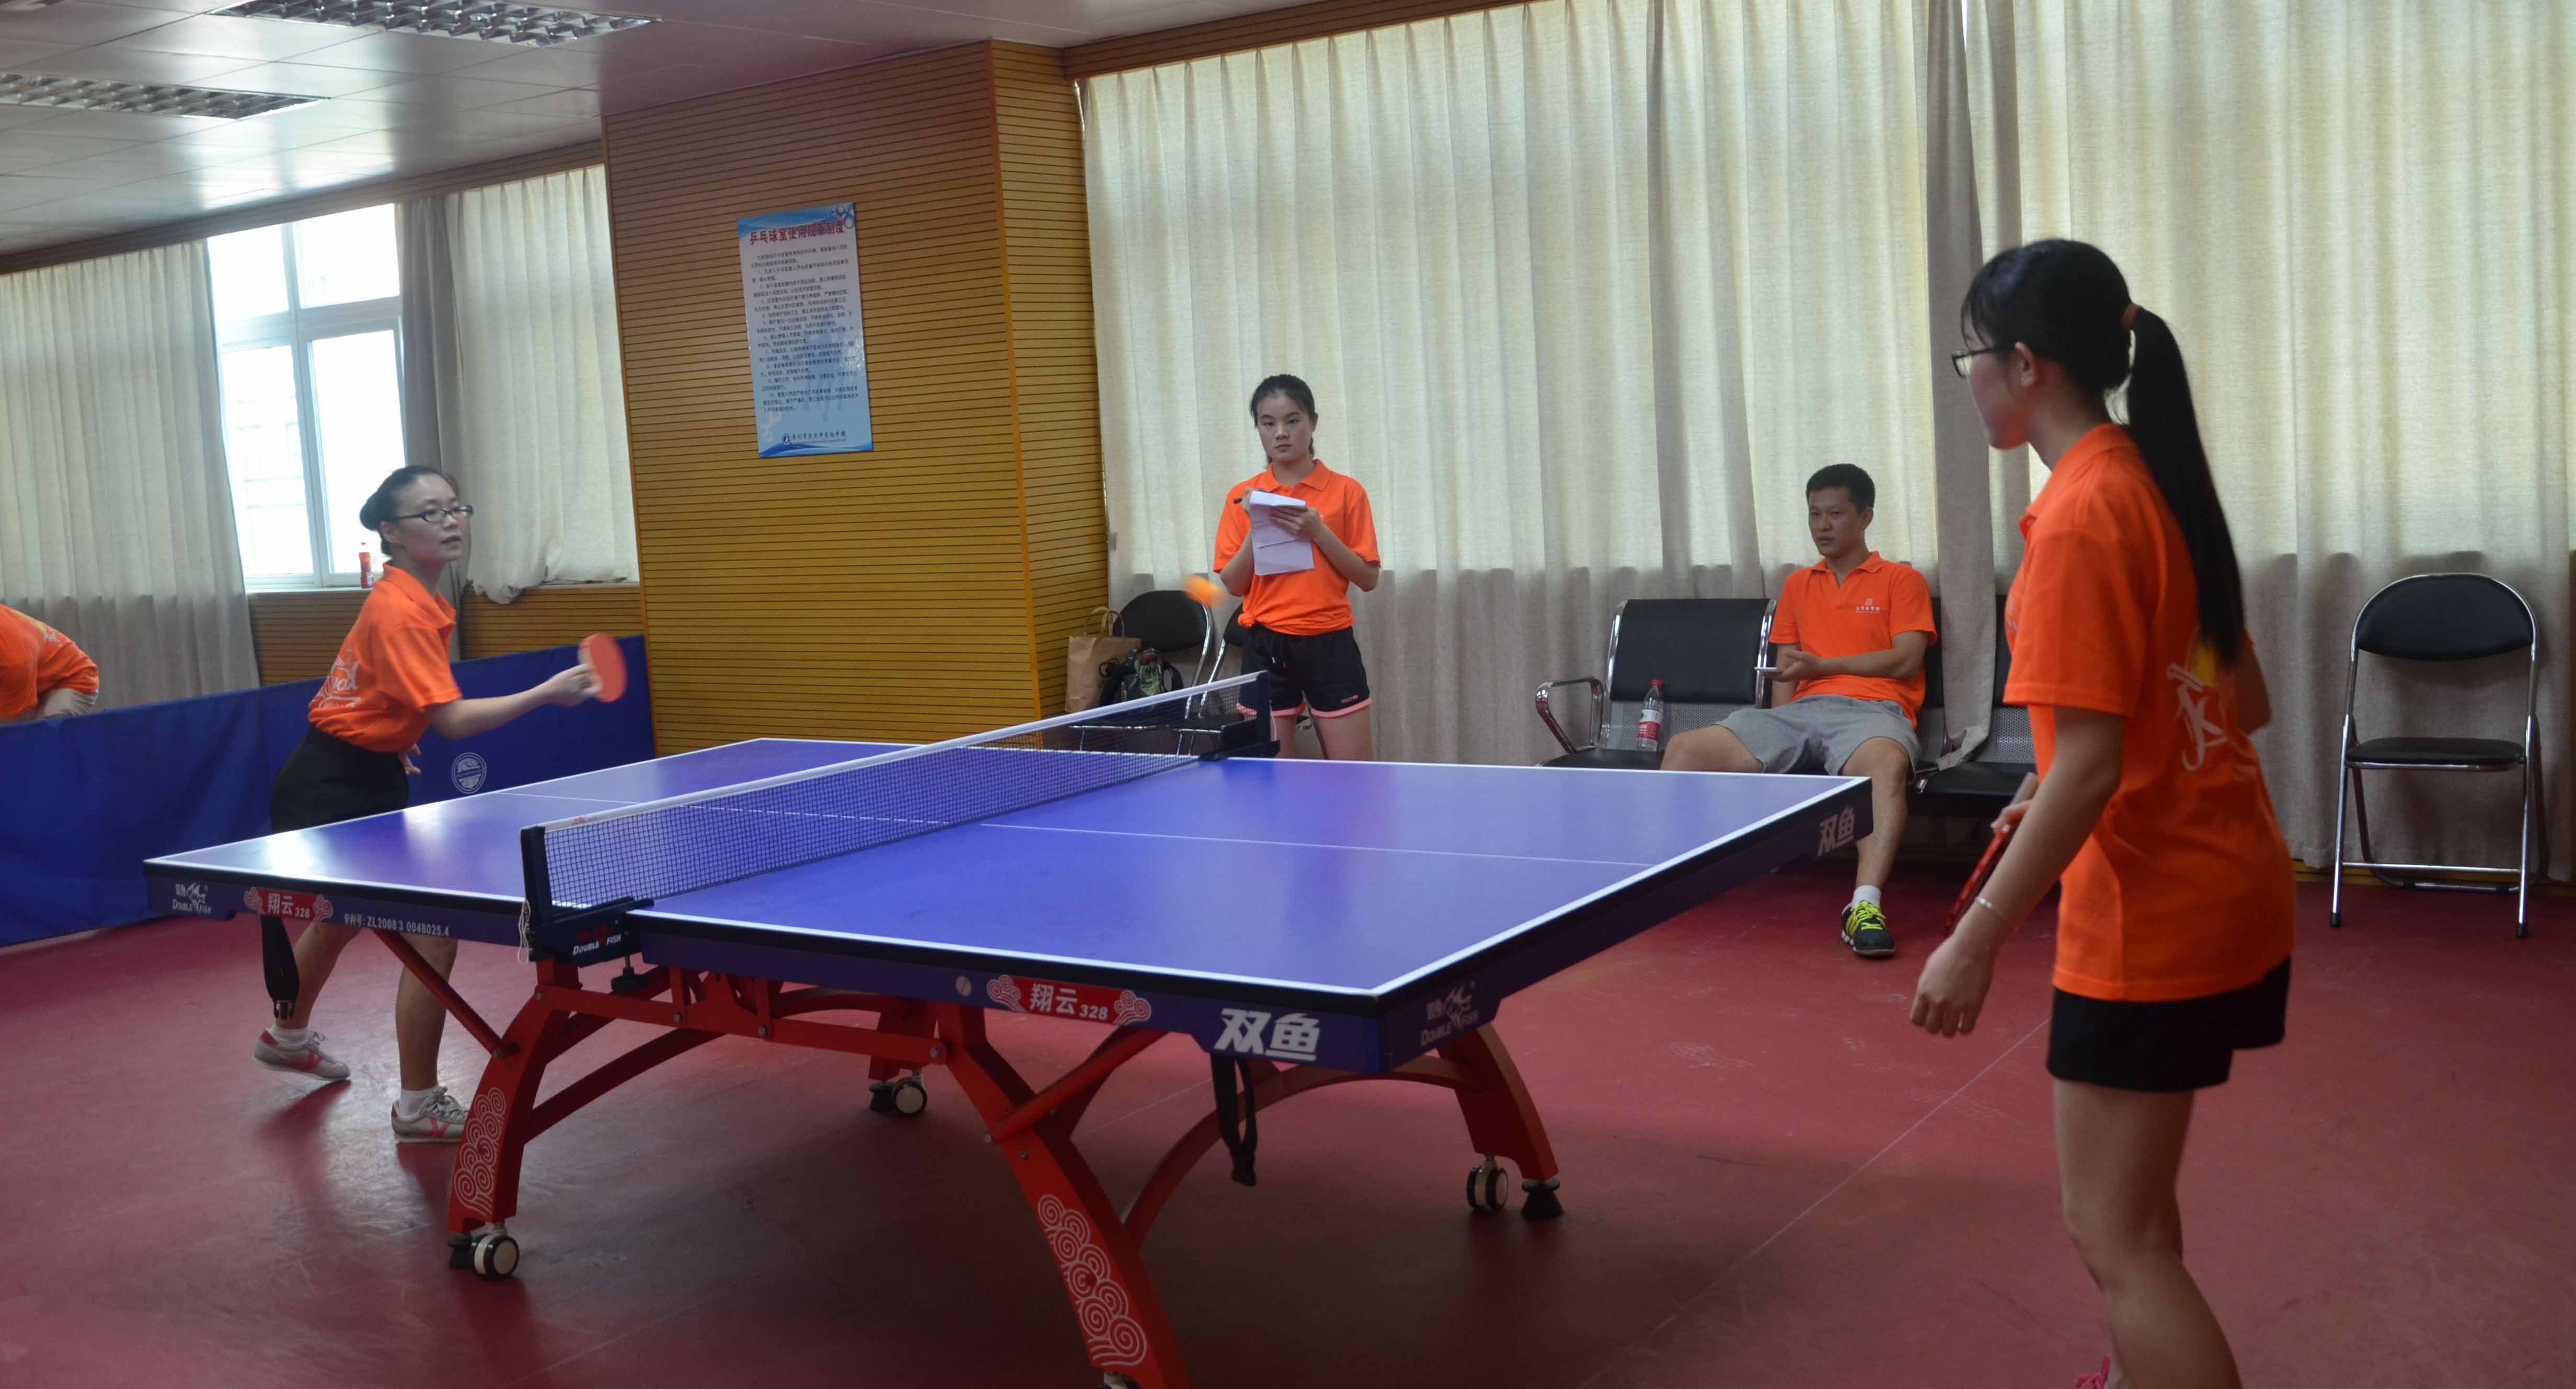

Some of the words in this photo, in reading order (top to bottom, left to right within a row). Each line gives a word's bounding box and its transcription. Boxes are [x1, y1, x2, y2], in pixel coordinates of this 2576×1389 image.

[1818, 806, 1855, 857] 双鱼
[268, 893, 293, 916] 翔云
[295, 907, 310, 919] 328
[1029, 983, 1078, 1015] 翔云
[1079, 1003, 1109, 1021] 328
[1213, 1008, 1321, 1062] 双鱼
